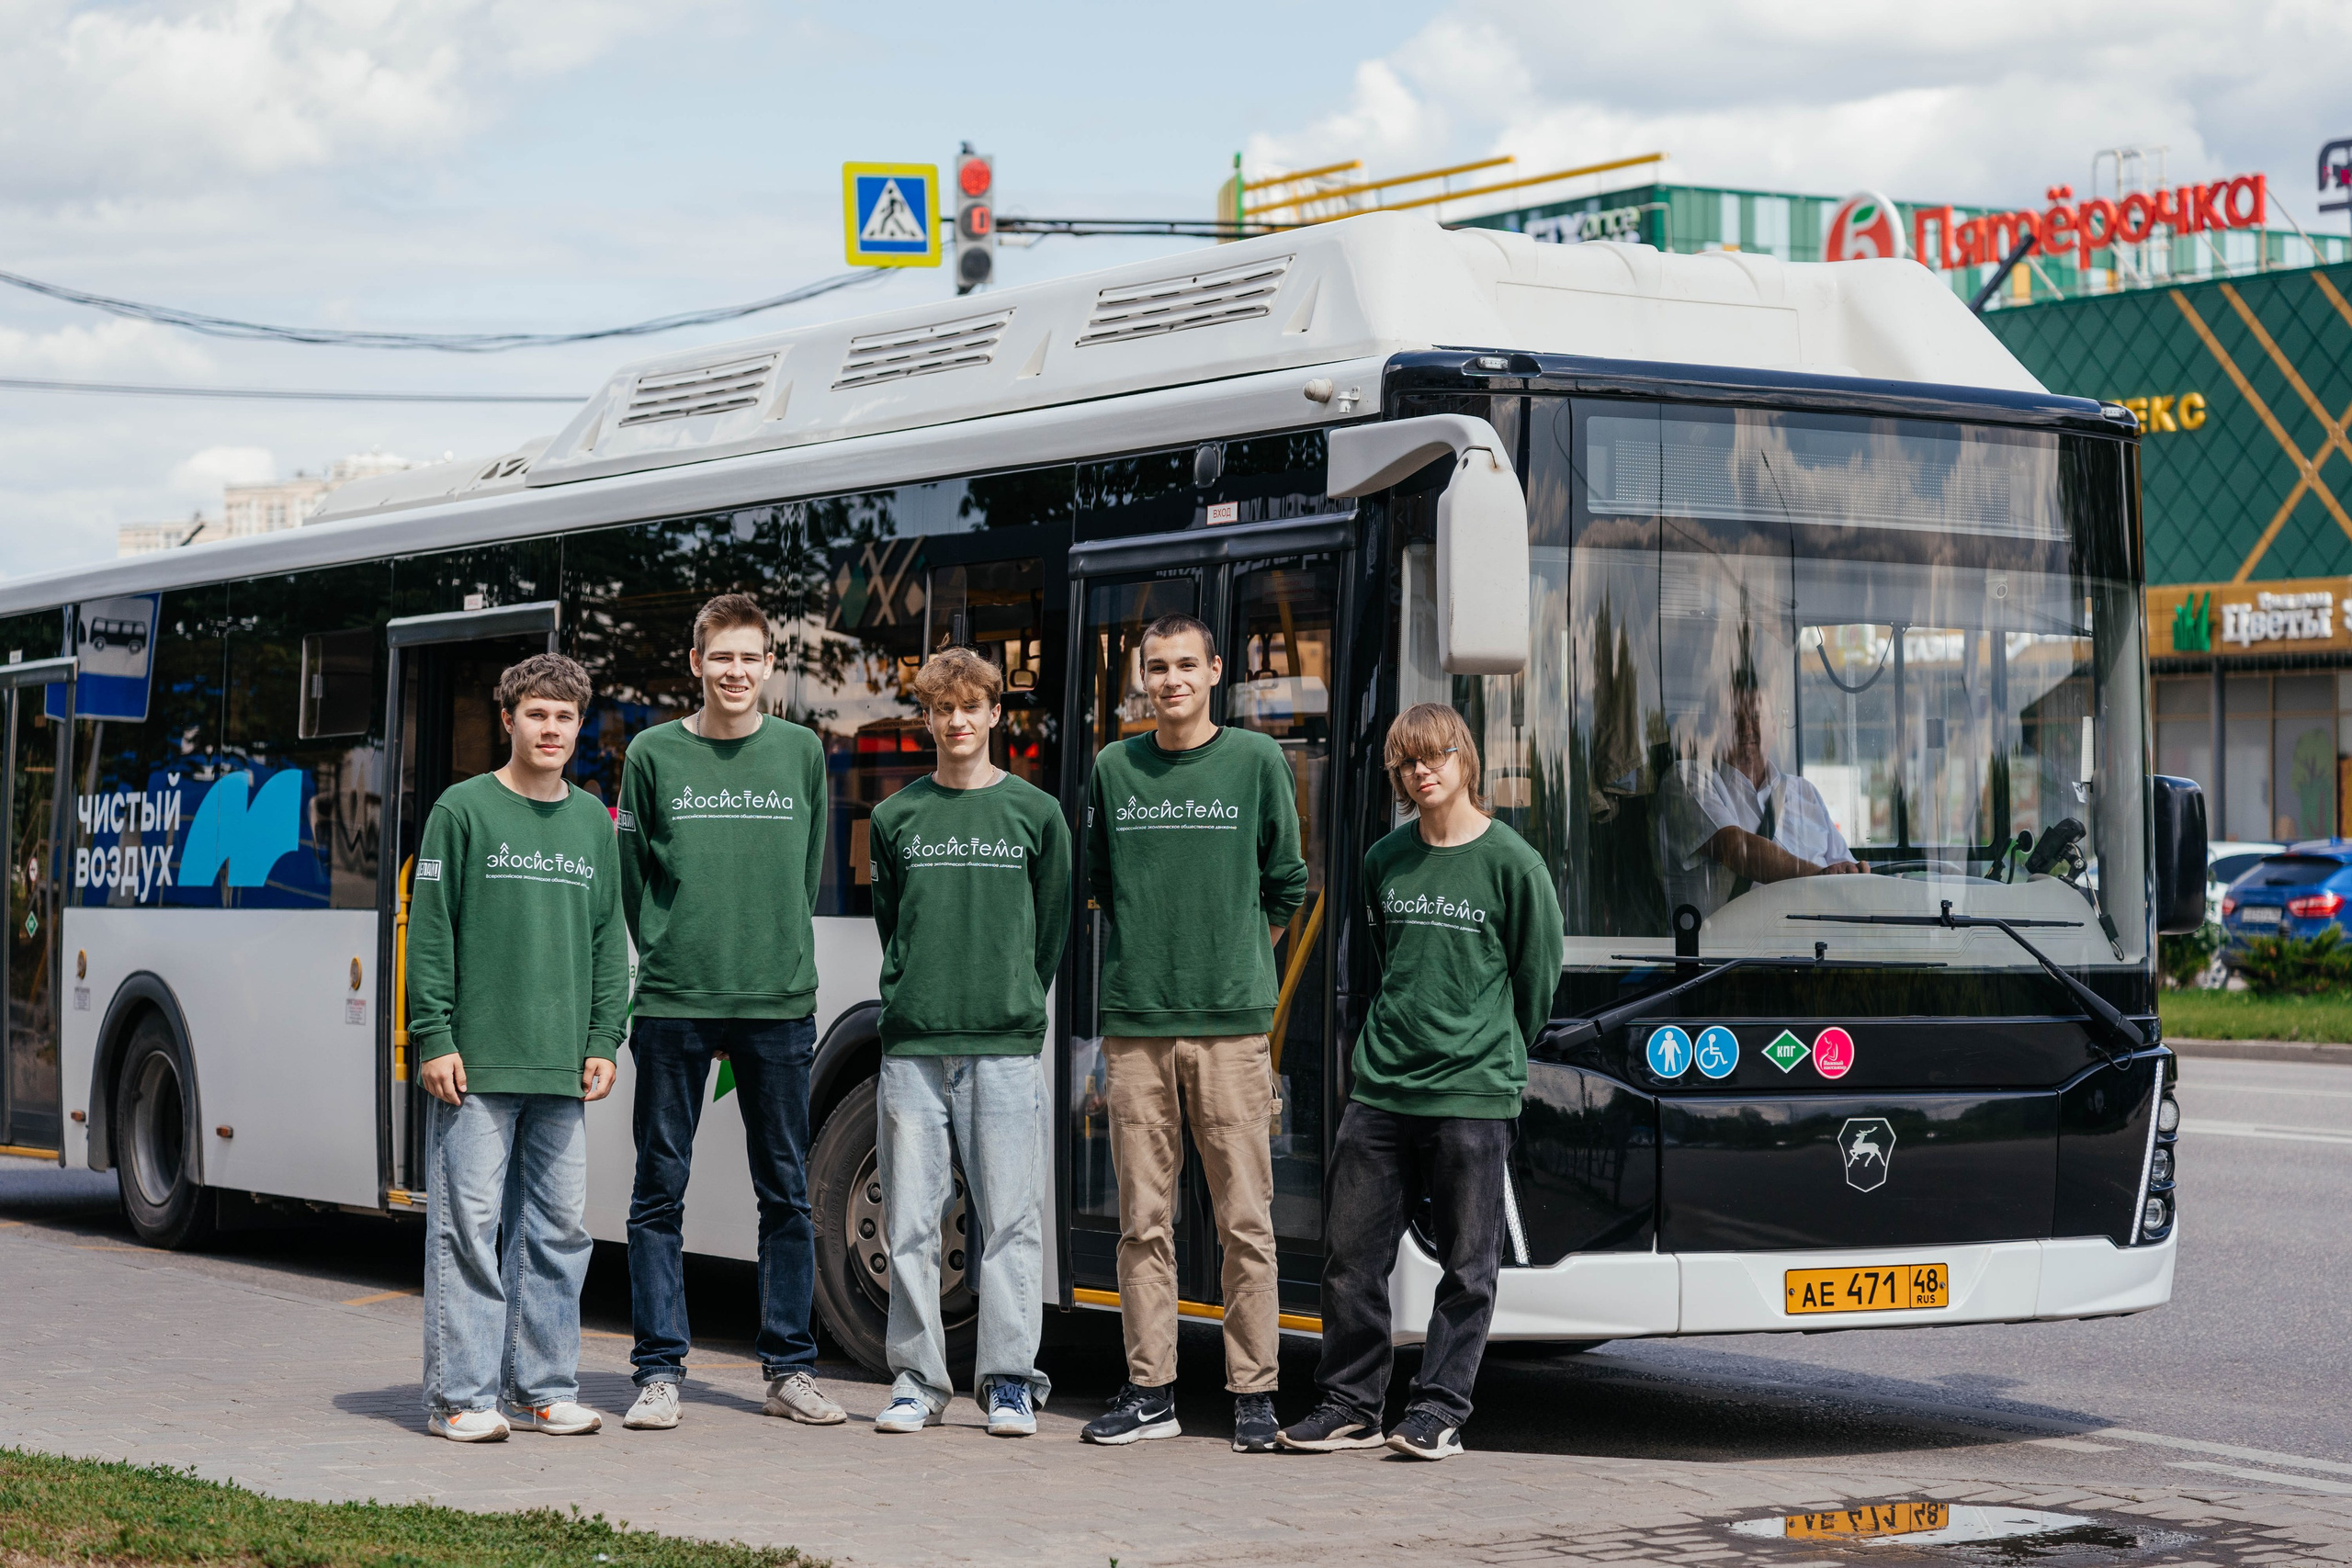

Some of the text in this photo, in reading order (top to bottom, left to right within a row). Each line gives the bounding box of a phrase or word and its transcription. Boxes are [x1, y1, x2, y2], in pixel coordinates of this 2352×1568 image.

[1916, 172, 2266, 271] Пятёрочка
[1213, 507, 1231, 518] ВХОД
[2222, 603, 2333, 648] Цветы
[1777, 1045, 1796, 1057] КПГ
[1847, 1271, 1895, 1304] 471
[1914, 1269, 1939, 1293] 48
[1917, 1294, 1936, 1304] RUS
